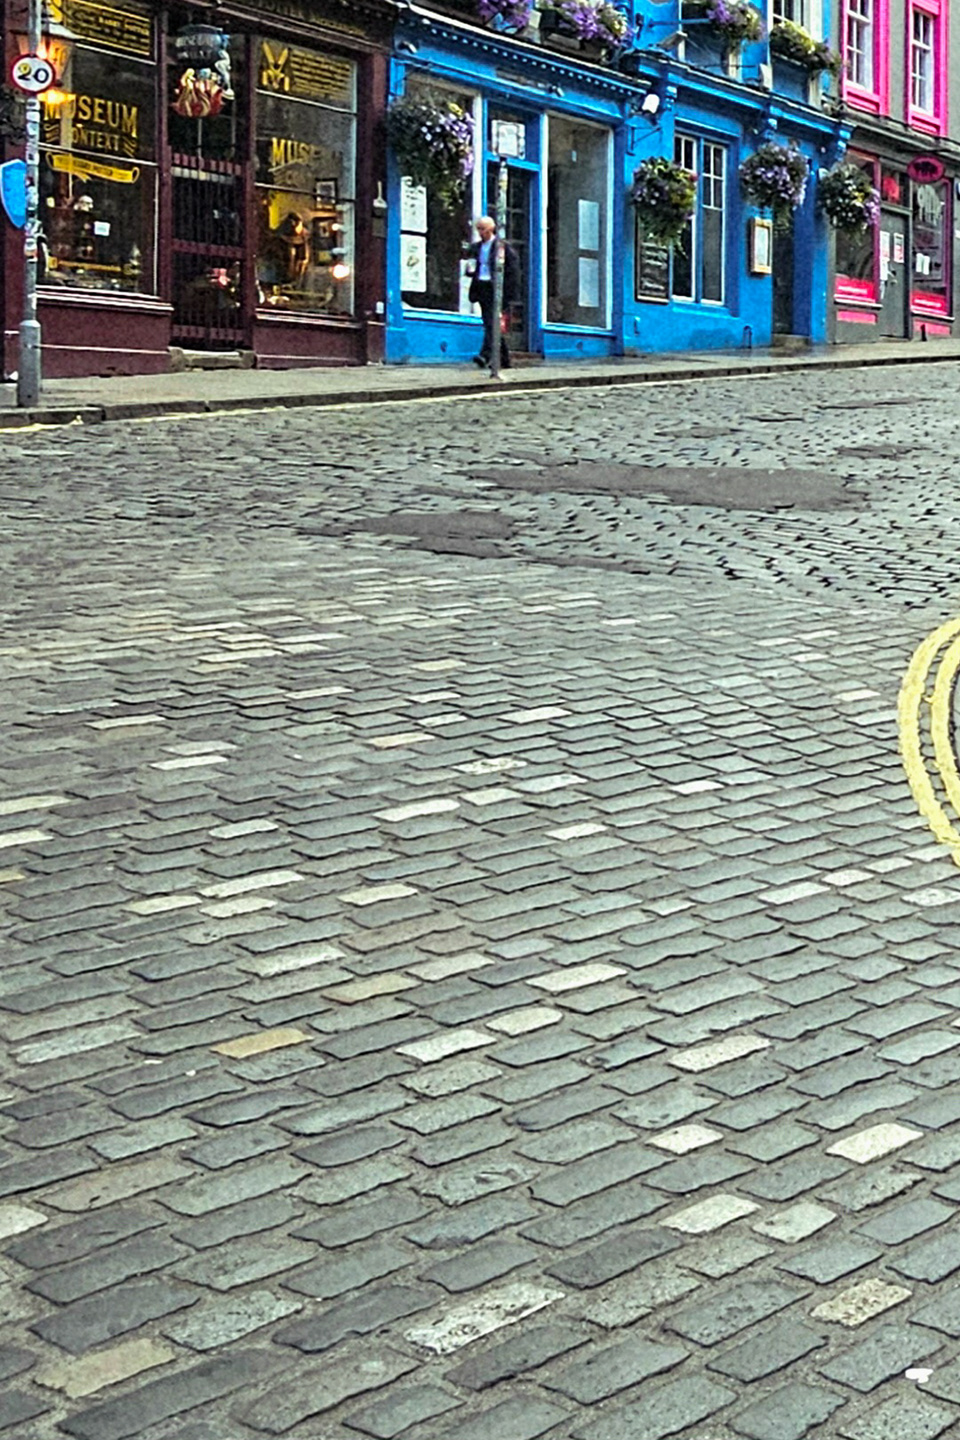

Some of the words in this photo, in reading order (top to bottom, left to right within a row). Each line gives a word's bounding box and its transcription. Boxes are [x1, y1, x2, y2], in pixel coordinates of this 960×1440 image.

[18, 63, 49, 84] 20
[43, 95, 138, 139] MUSEUM
[71, 126, 119, 152] ONTEXT
